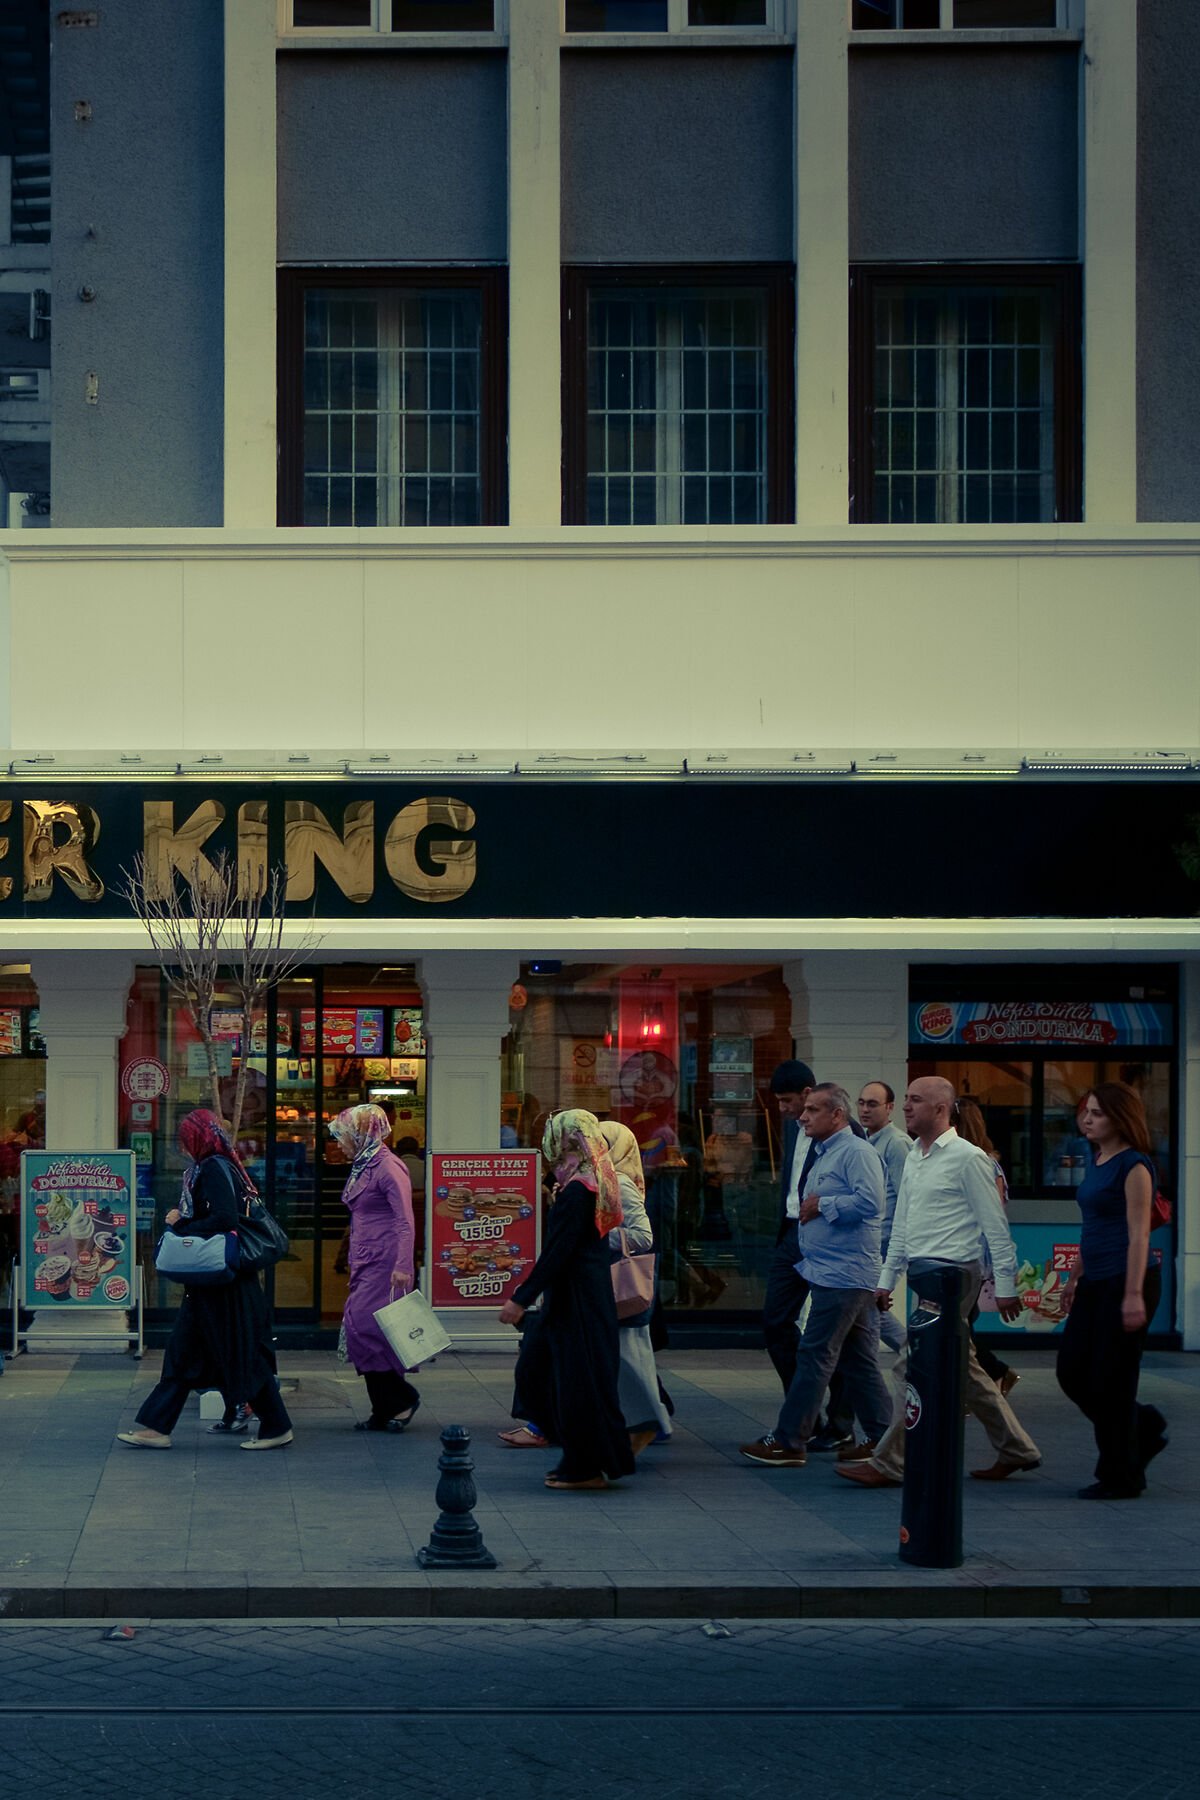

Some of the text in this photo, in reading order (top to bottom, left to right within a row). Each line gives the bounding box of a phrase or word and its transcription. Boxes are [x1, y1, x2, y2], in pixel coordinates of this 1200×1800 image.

[143, 796, 478, 904] KING
[921, 1007, 952, 1022] BURGER
[987, 1002, 1034, 1021] Nefis
[921, 1015, 952, 1032] KING
[975, 1020, 1105, 1042] DONDURMA
[441, 1157, 529, 1171] GERÇEK FİYAT
[39, 1175, 119, 1189] DONDURMA
[482, 1217, 489, 1225] 2
[481, 1273, 487, 1281] 2
[1023, 1294, 1041, 1302] YENİ
